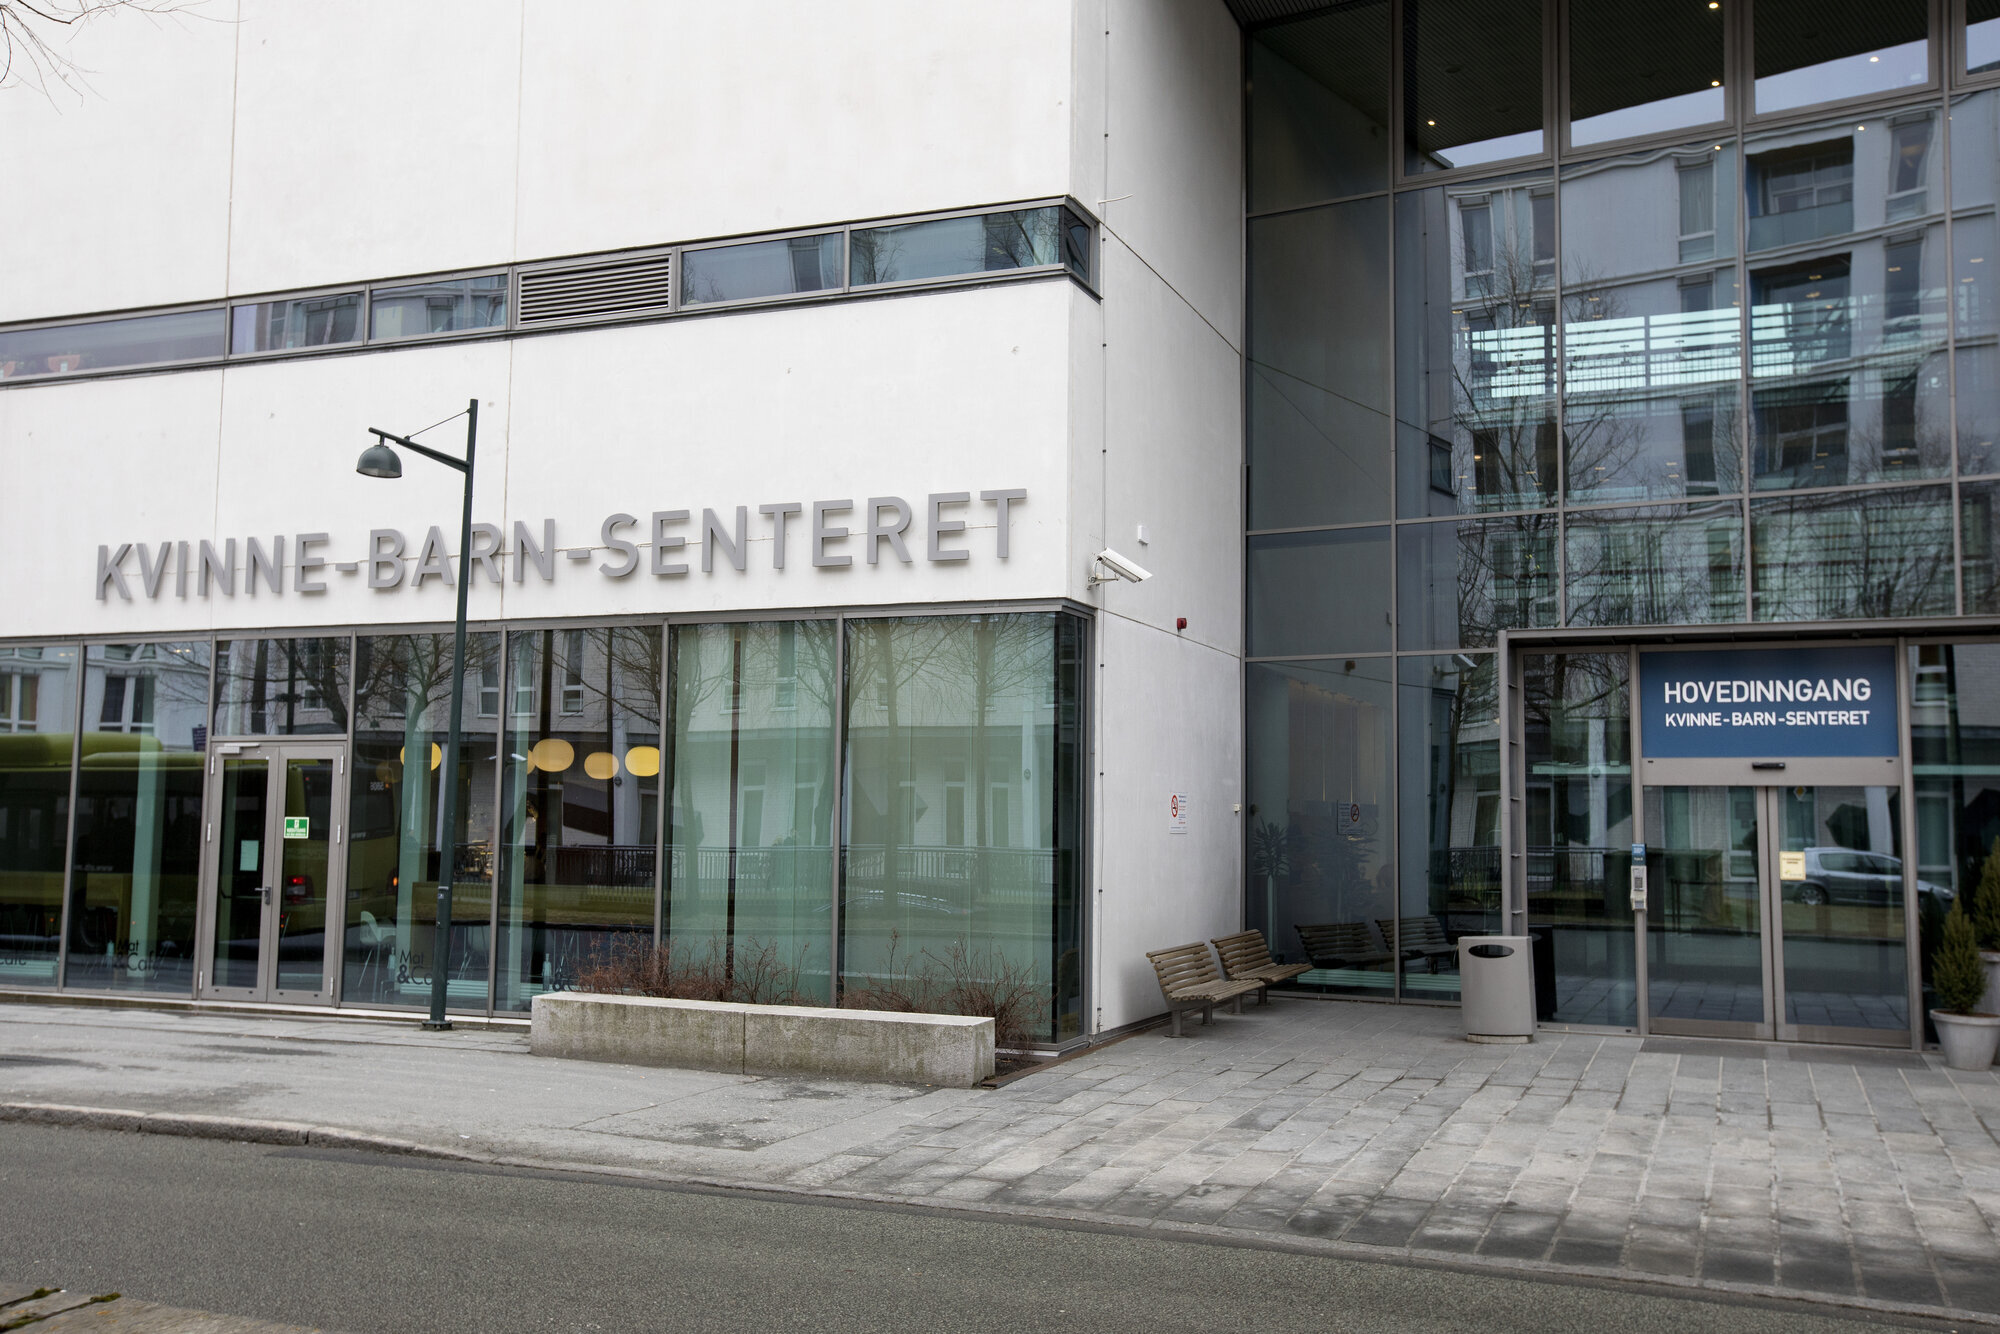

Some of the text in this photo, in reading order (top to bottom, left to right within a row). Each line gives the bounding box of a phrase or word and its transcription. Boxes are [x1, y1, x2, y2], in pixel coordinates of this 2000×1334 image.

[96, 488, 1027, 600] KVINNE-BARN-SENTERET
[1664, 677, 1872, 704] HOVEDINNGANG
[1665, 710, 1870, 727] KVINNE-BARN-SENTERET
[400, 949, 424, 965] Mat
